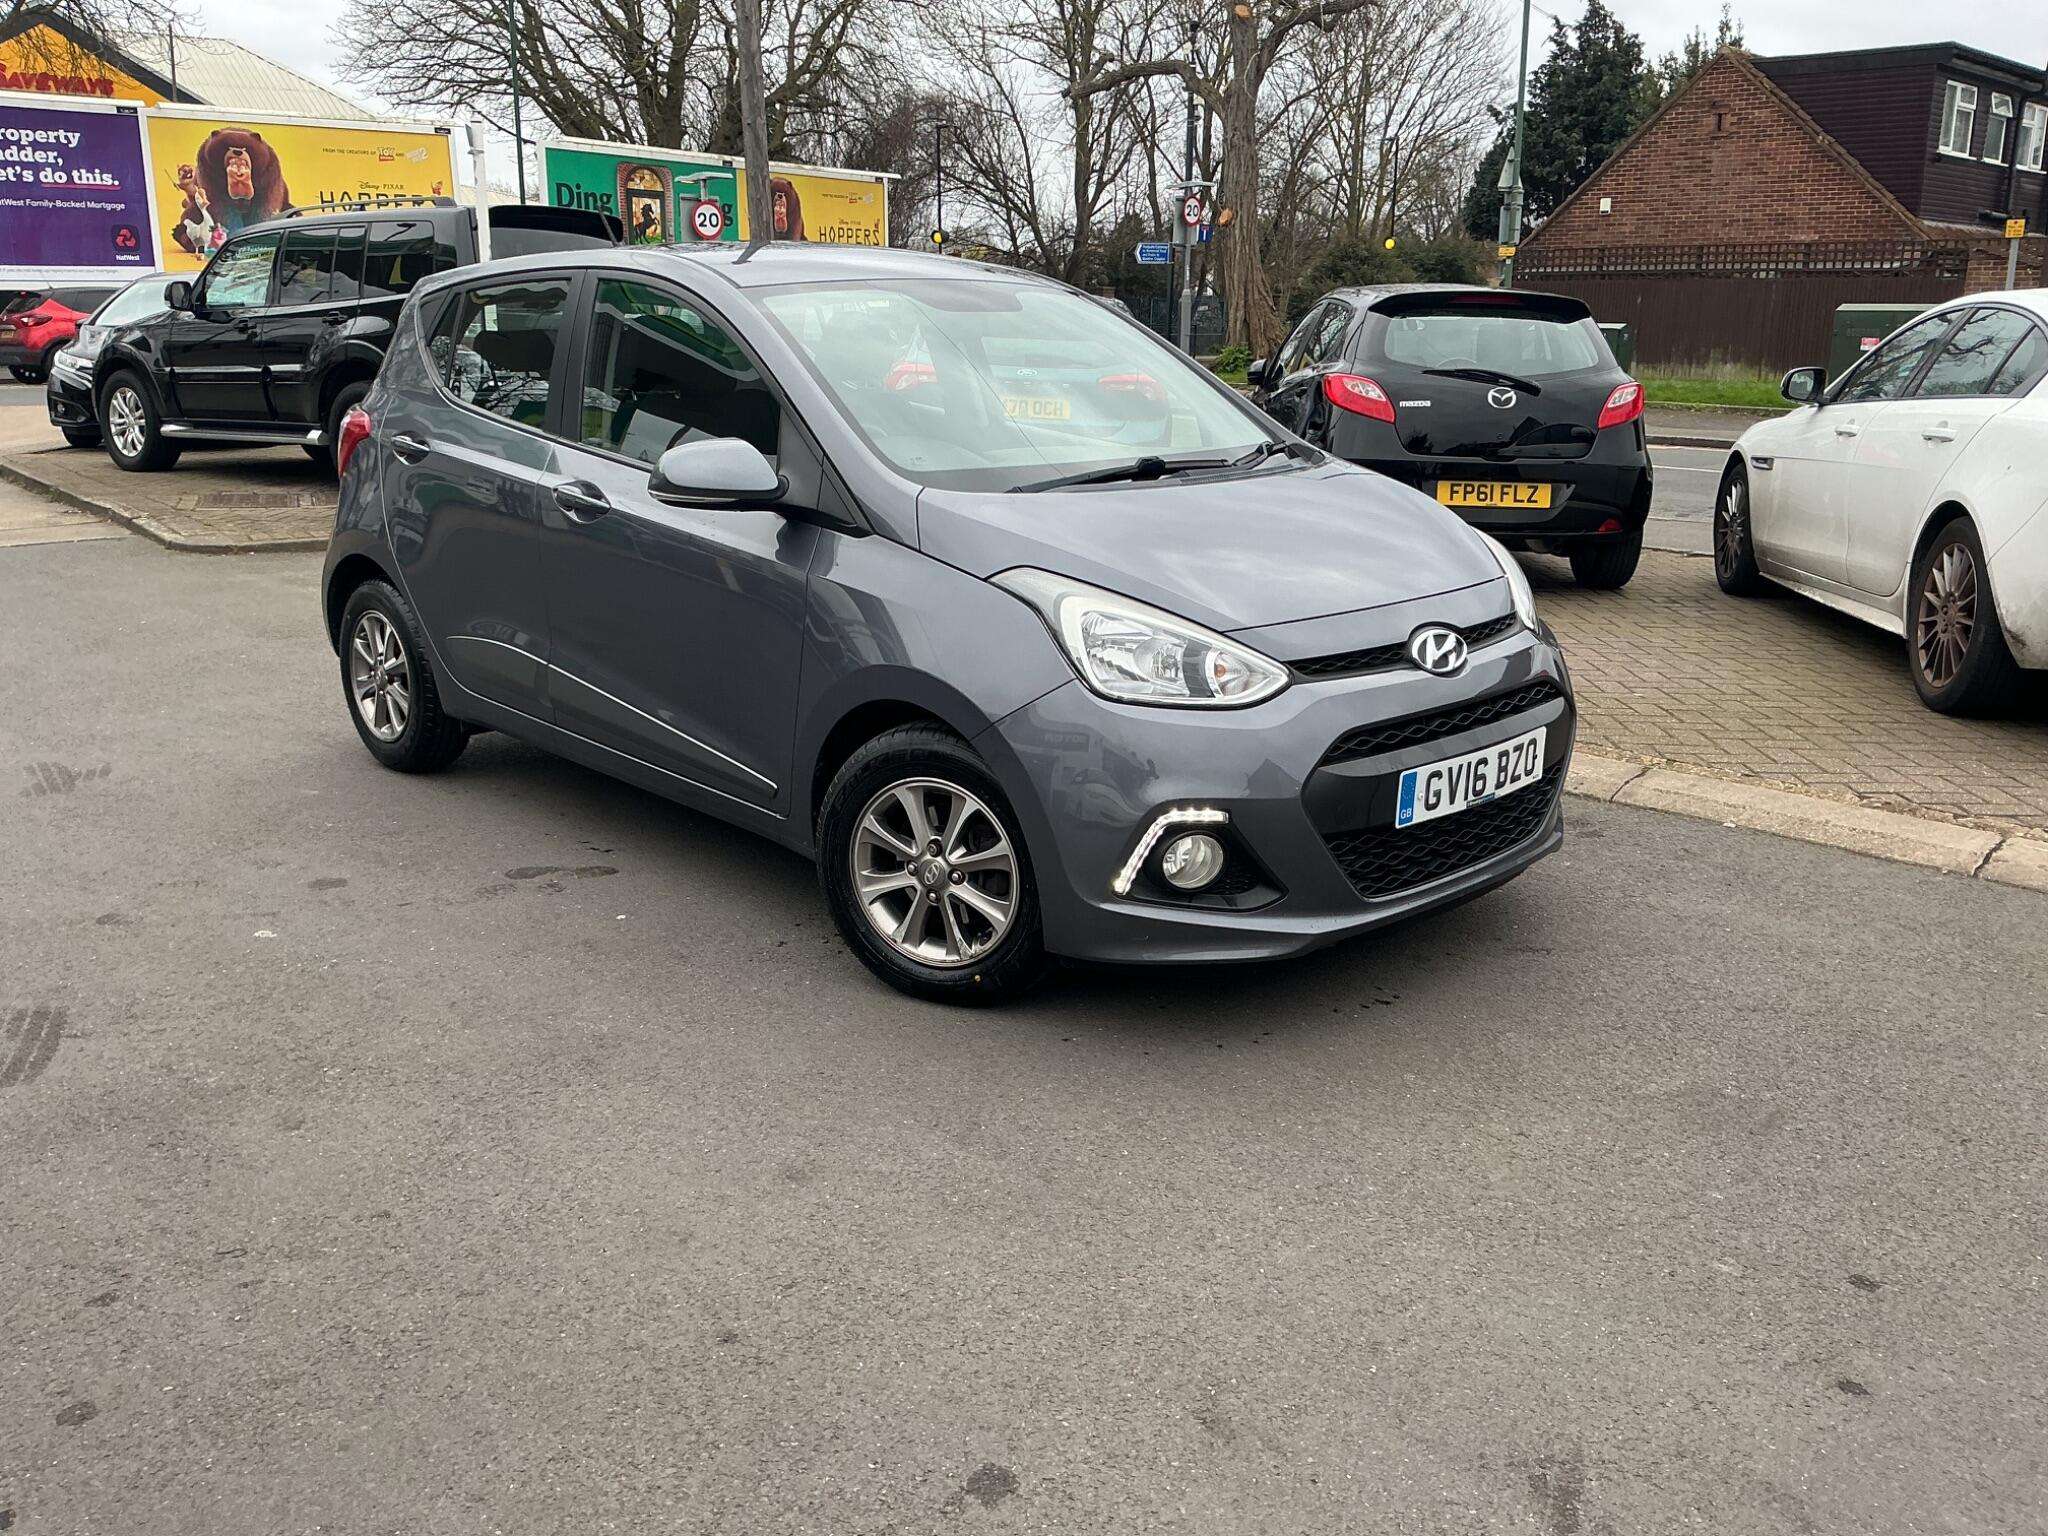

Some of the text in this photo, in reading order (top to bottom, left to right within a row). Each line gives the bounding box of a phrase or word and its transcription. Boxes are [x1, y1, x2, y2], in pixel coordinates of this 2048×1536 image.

[0, 127, 81, 148] roperty
[0, 145, 64, 167] dder,
[0, 165, 120, 185] et's do this.
[0, 198, 126, 210] tWest Family-Backed Mortgage
[555, 182, 613, 214] Ding
[697, 211, 719, 228] 20
[1186, 204, 1199, 217] 20
[819, 225, 880, 246] HOPPERS
[1449, 483, 1539, 504] FP61 FLZ
[1423, 756, 1489, 812] GV16
[1400, 807, 1412, 819] GB
